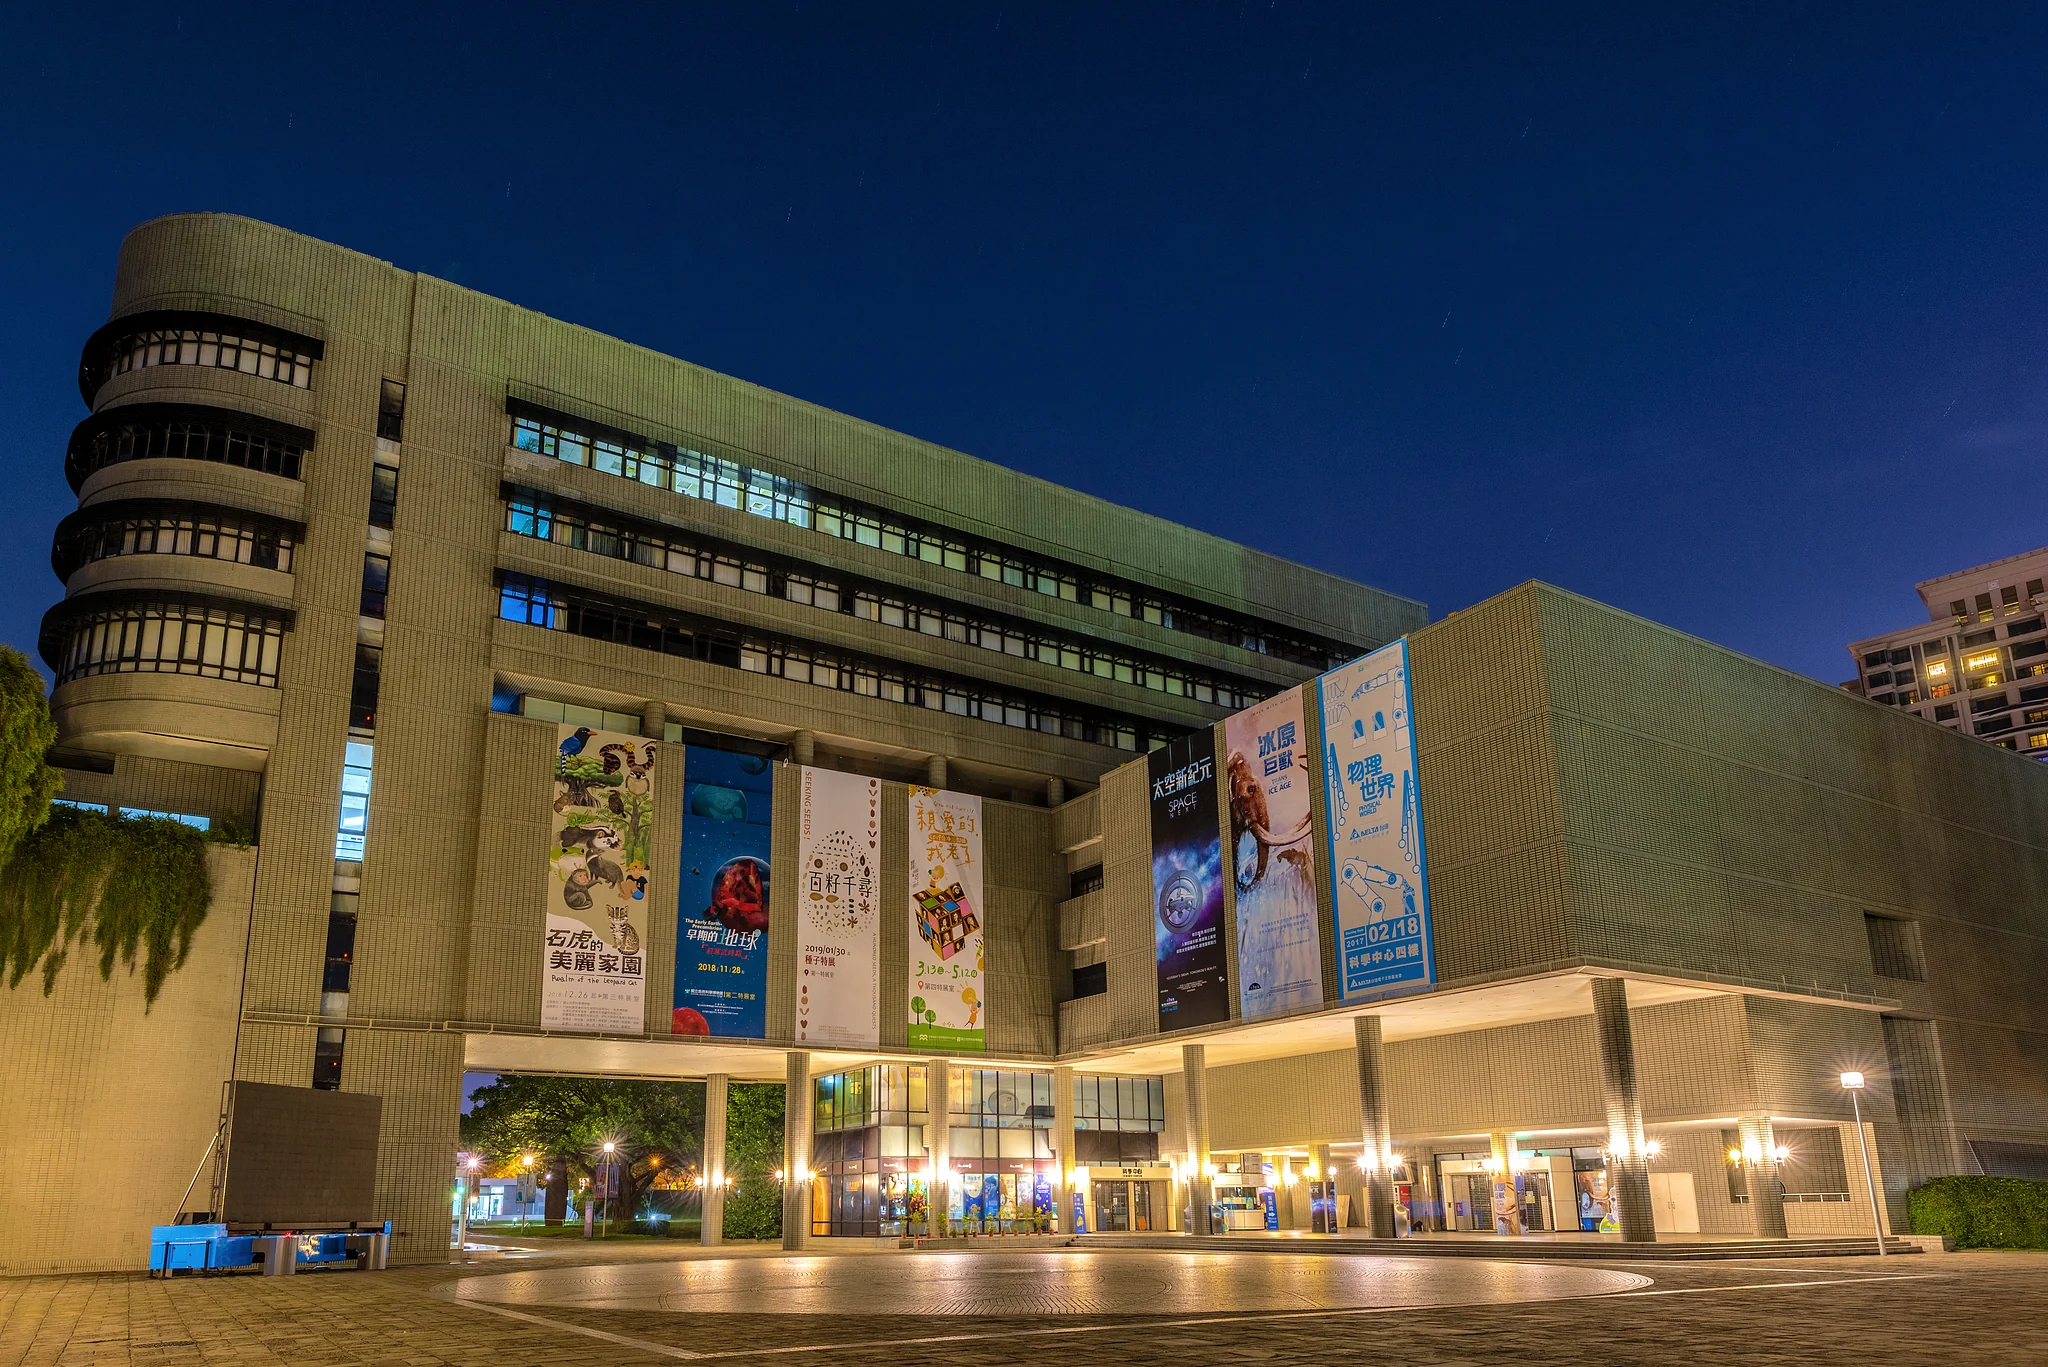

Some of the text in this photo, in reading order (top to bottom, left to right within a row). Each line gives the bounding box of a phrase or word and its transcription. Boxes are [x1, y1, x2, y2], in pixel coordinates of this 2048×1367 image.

[1258, 721, 1296, 758] 冰原
[1264, 750, 1293, 776] 巨獸
[1348, 754, 1382, 784] 物理
[1153, 756, 1212, 800] 太空新紀元
[1268, 781, 1291, 795] ICE AGE
[1360, 773, 1395, 802] 世界
[1169, 792, 1197, 812] SPACE
[1170, 804, 1196, 818] NEXT
[1359, 801, 1381, 812] PHYSICAL
[1360, 808, 1376, 817] WORLD
[1361, 827, 1378, 836] DELTA
[926, 843, 970, 863] 我老了
[809, 871, 872, 898] 百籽千尋
[546, 929, 603, 951] 石虎的
[686, 928, 760, 950] 早期的地球
[1369, 918, 1418, 942] 02/18
[805, 945, 845, 956] 2019/01/30
[1347, 938, 1363, 947] 2017
[550, 950, 642, 975] 美麗家園
[805, 955, 835, 967] 種子特展
[1349, 944, 1418, 969] 科學中心四樓
[925, 983, 954, 992] 第四特展室
